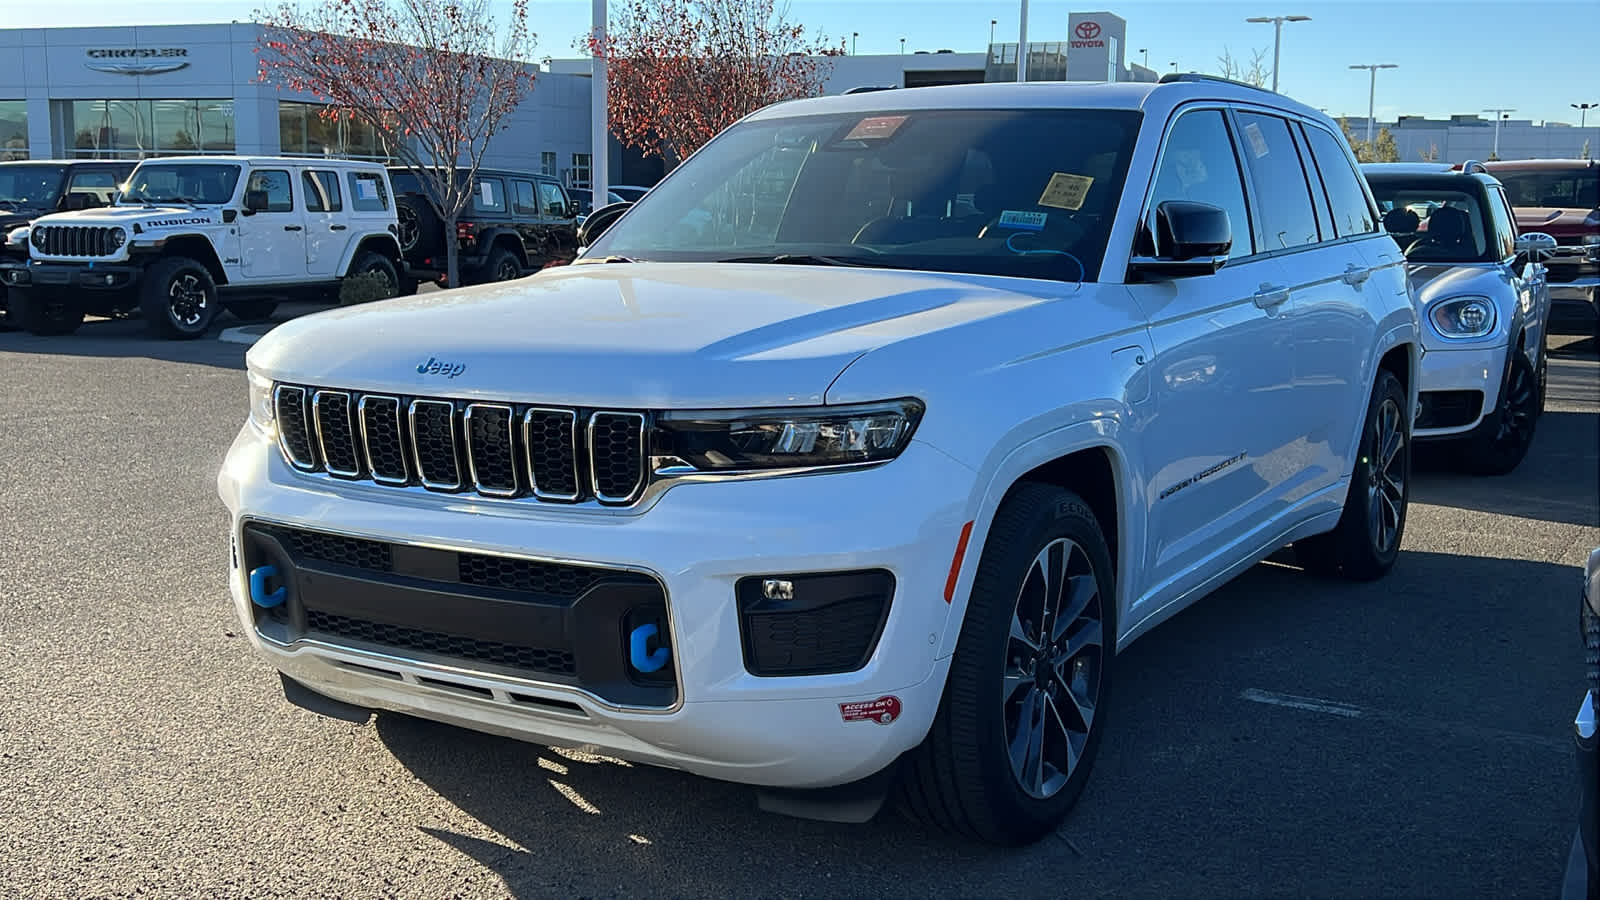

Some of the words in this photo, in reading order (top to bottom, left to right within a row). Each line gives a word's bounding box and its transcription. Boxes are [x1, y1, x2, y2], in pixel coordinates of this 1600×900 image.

[1070, 40, 1104, 48] TOYOTA
[86, 48, 188, 58] CHRYSLER
[146, 217, 211, 227] RUBICON
[416, 357, 466, 379] Jeep
[844, 702, 874, 710] ACCESS
